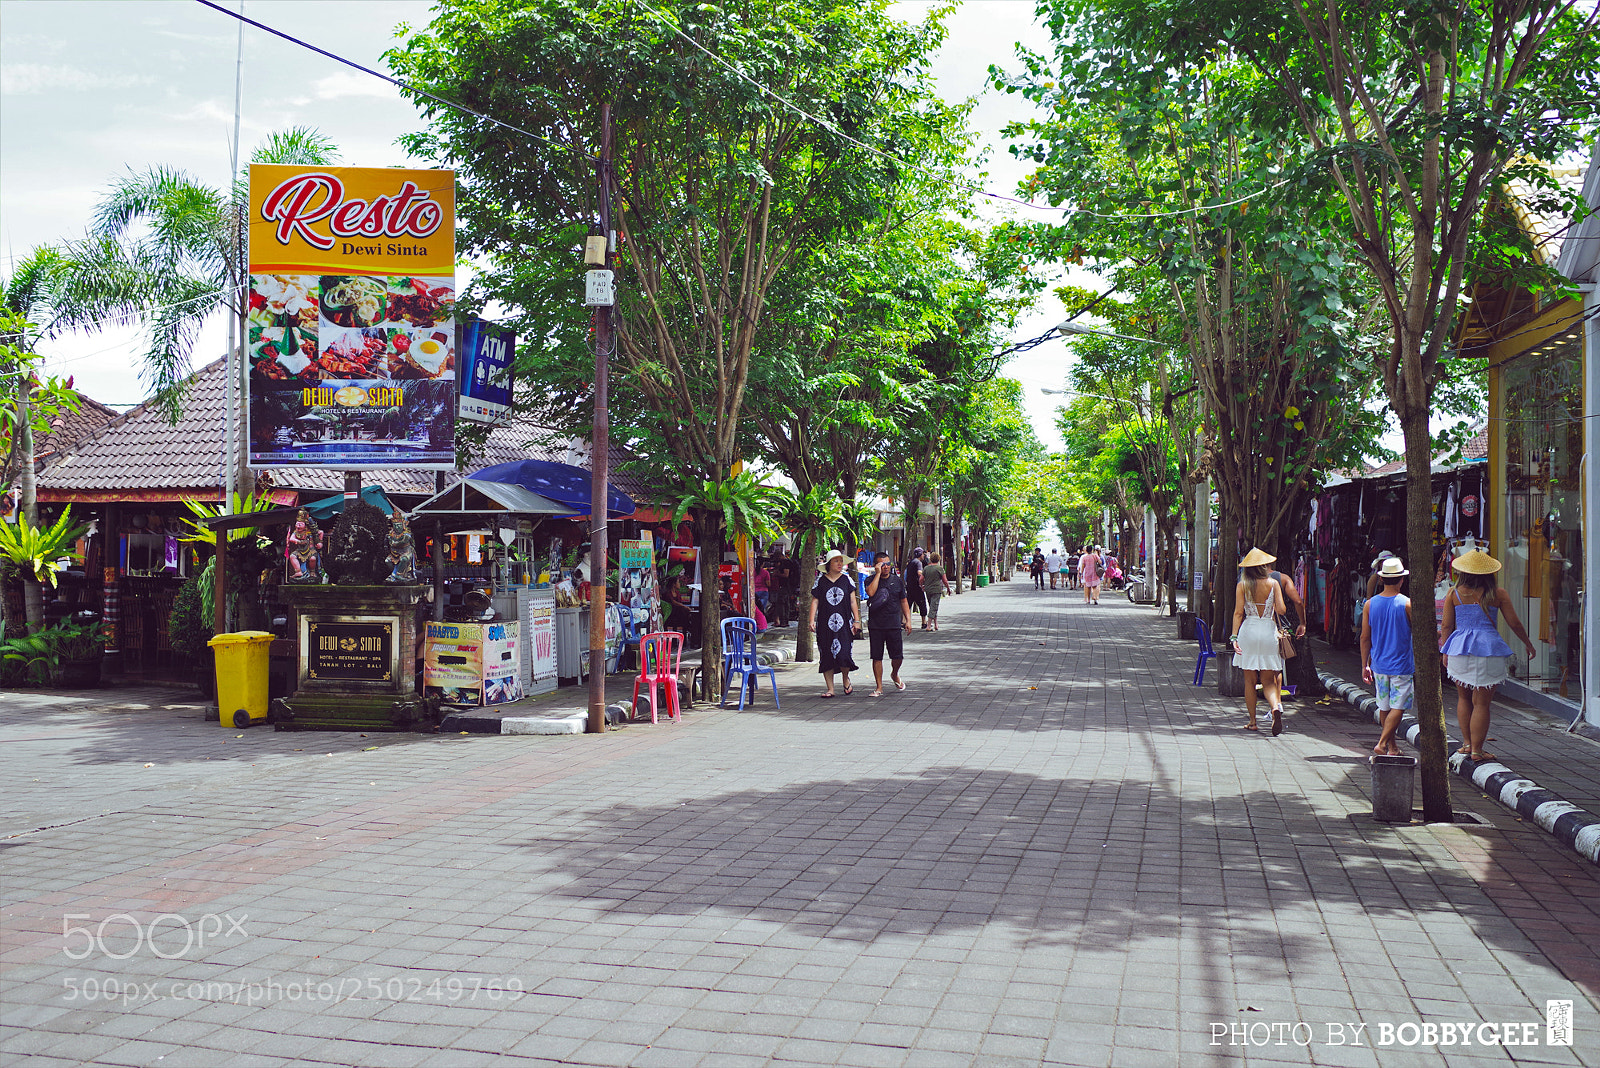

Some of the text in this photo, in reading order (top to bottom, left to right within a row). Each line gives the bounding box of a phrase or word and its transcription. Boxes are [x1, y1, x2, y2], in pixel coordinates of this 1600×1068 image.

[261, 173, 444, 249] Resto
[342, 242, 428, 256] Dewi Sinta
[480, 335, 507, 362] ATM
[303, 387, 404, 407] DEWI SINTA
[621, 540, 640, 550] TATTOO
[427, 625, 459, 639] ROASTED
[319, 636, 382, 652] DEWI SINTA
